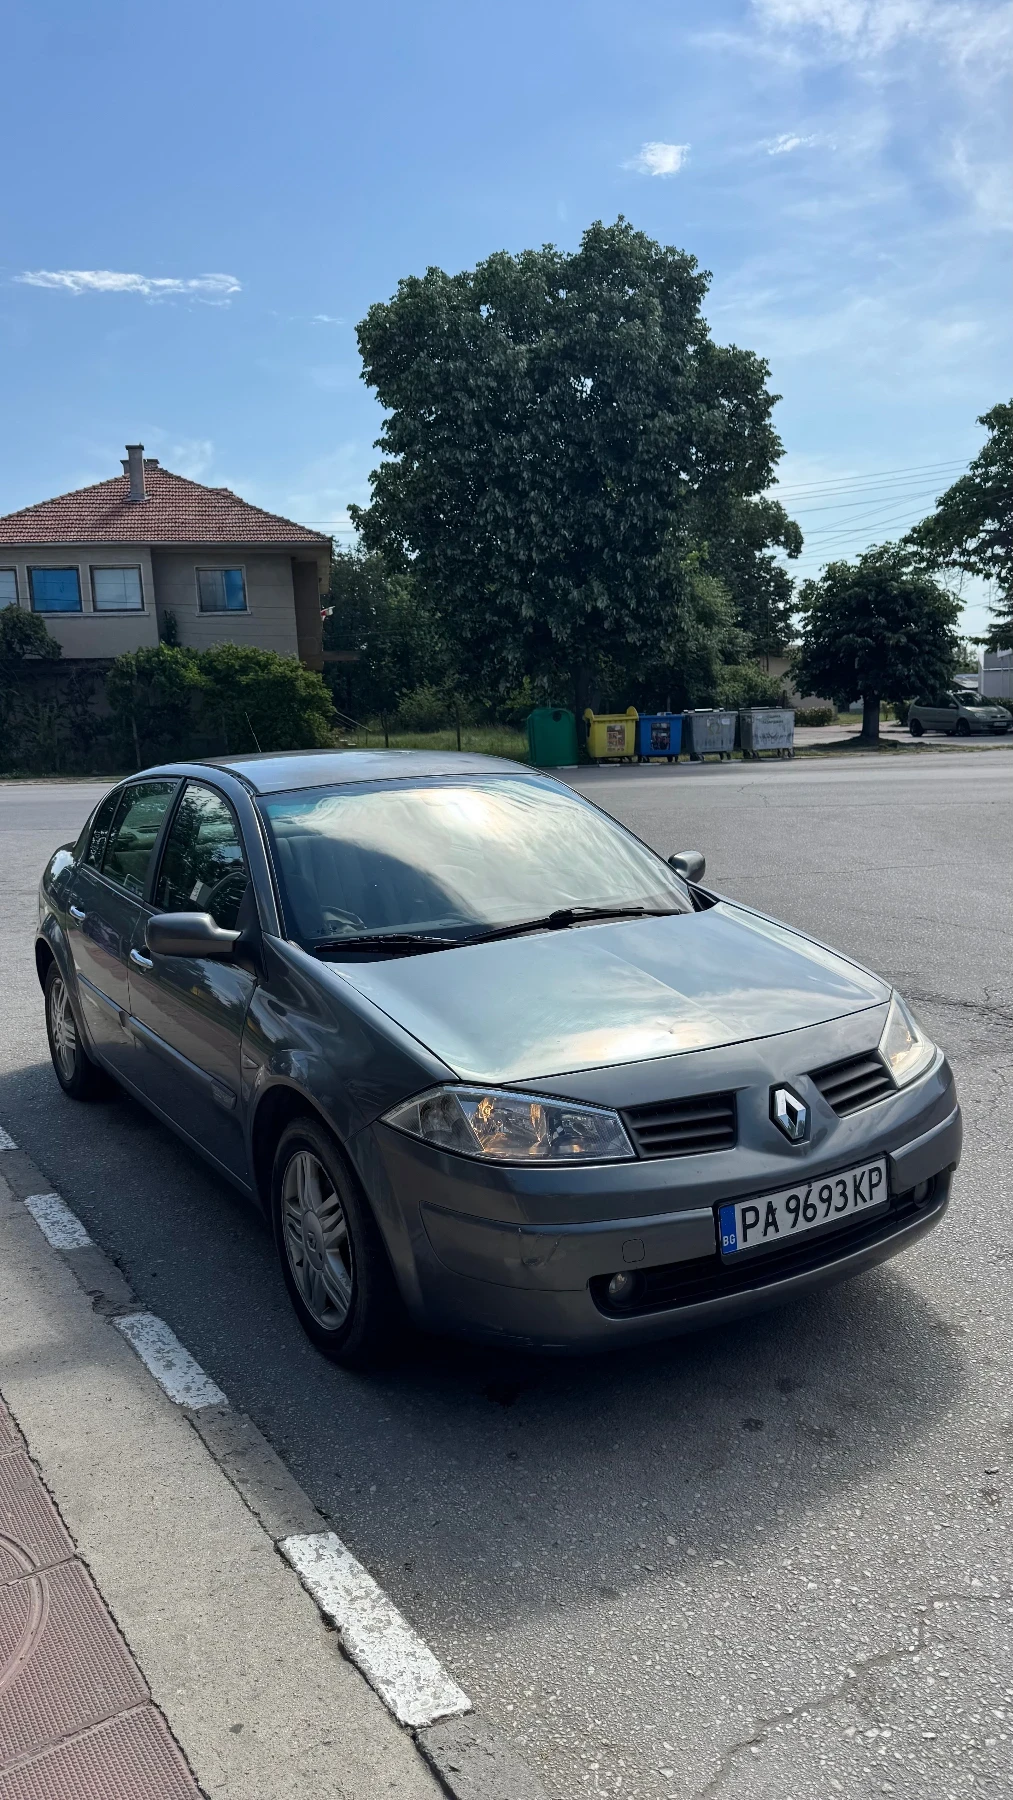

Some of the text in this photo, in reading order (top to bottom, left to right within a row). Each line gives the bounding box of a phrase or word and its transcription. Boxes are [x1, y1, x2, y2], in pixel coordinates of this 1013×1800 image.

[741, 1166, 883, 1242] PA 9693 KP
[722, 1233, 736, 1246] BG
